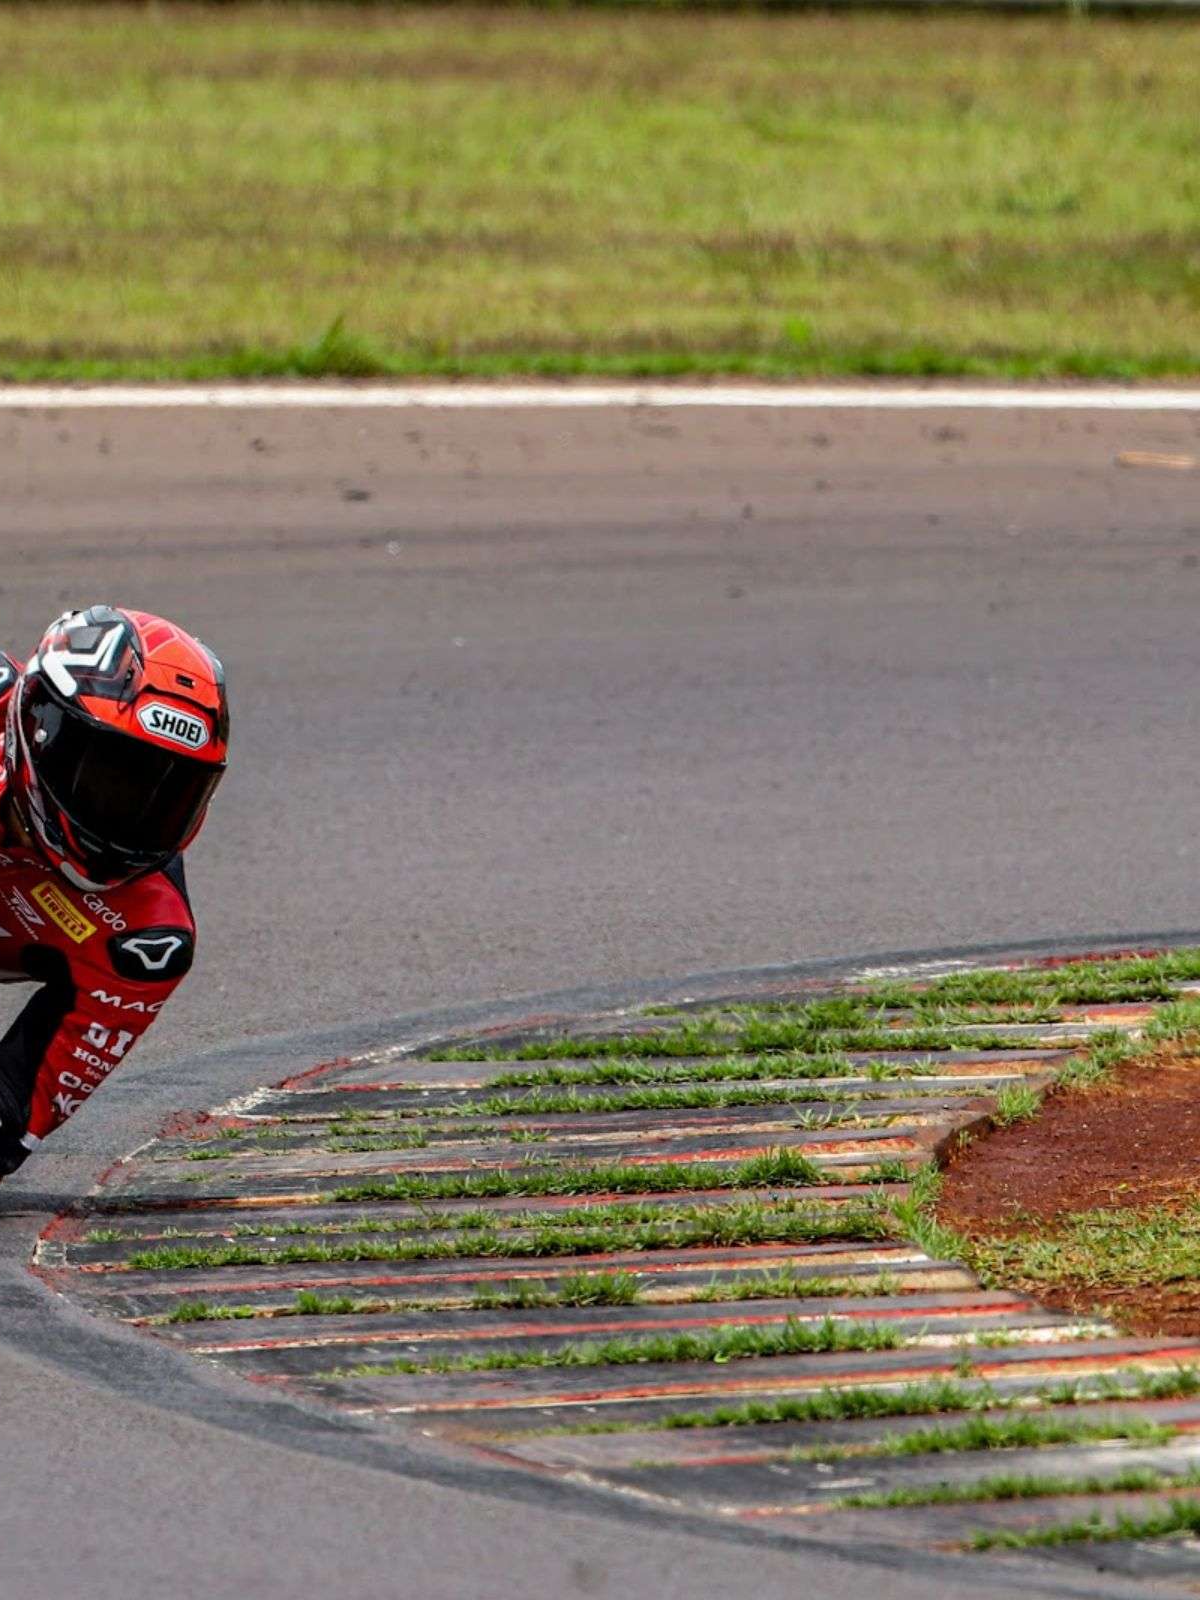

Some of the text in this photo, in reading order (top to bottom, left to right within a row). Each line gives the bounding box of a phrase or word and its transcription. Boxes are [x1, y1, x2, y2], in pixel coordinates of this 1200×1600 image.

[148, 709, 203, 744] SHOEI
[40, 883, 88, 937] PIRELLI
[82, 892, 128, 932] cardo
